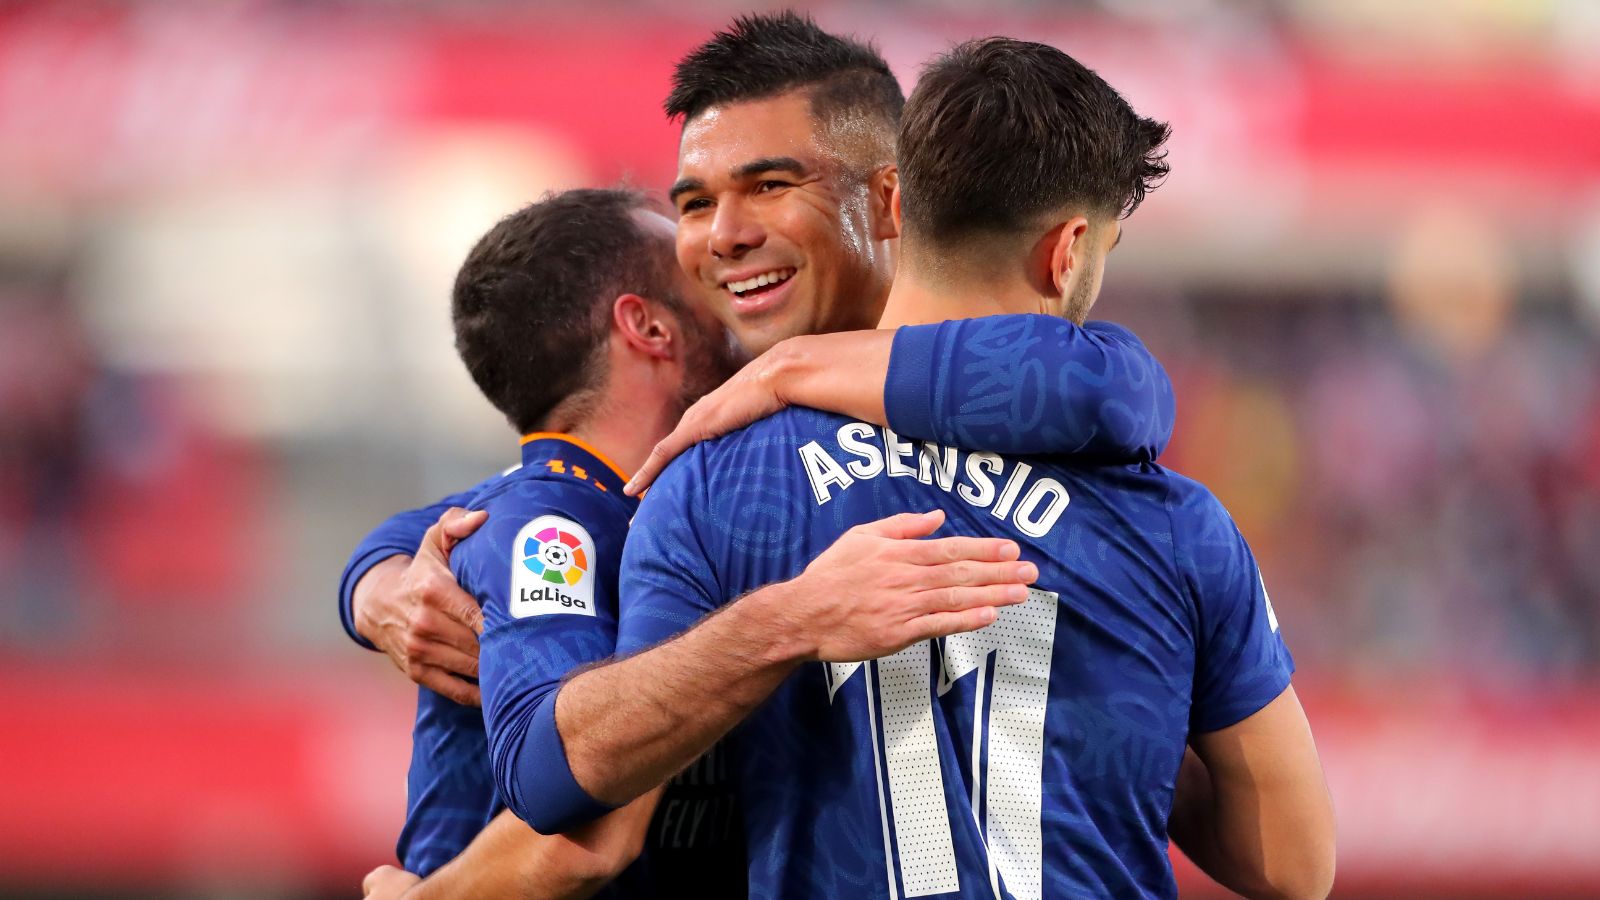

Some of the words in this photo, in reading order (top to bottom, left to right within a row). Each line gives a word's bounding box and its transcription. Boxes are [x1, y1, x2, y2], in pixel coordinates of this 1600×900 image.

[798, 422, 1070, 538] ASENSIO
[520, 587, 587, 609] LaLiga
[822, 586, 1058, 900] 11
